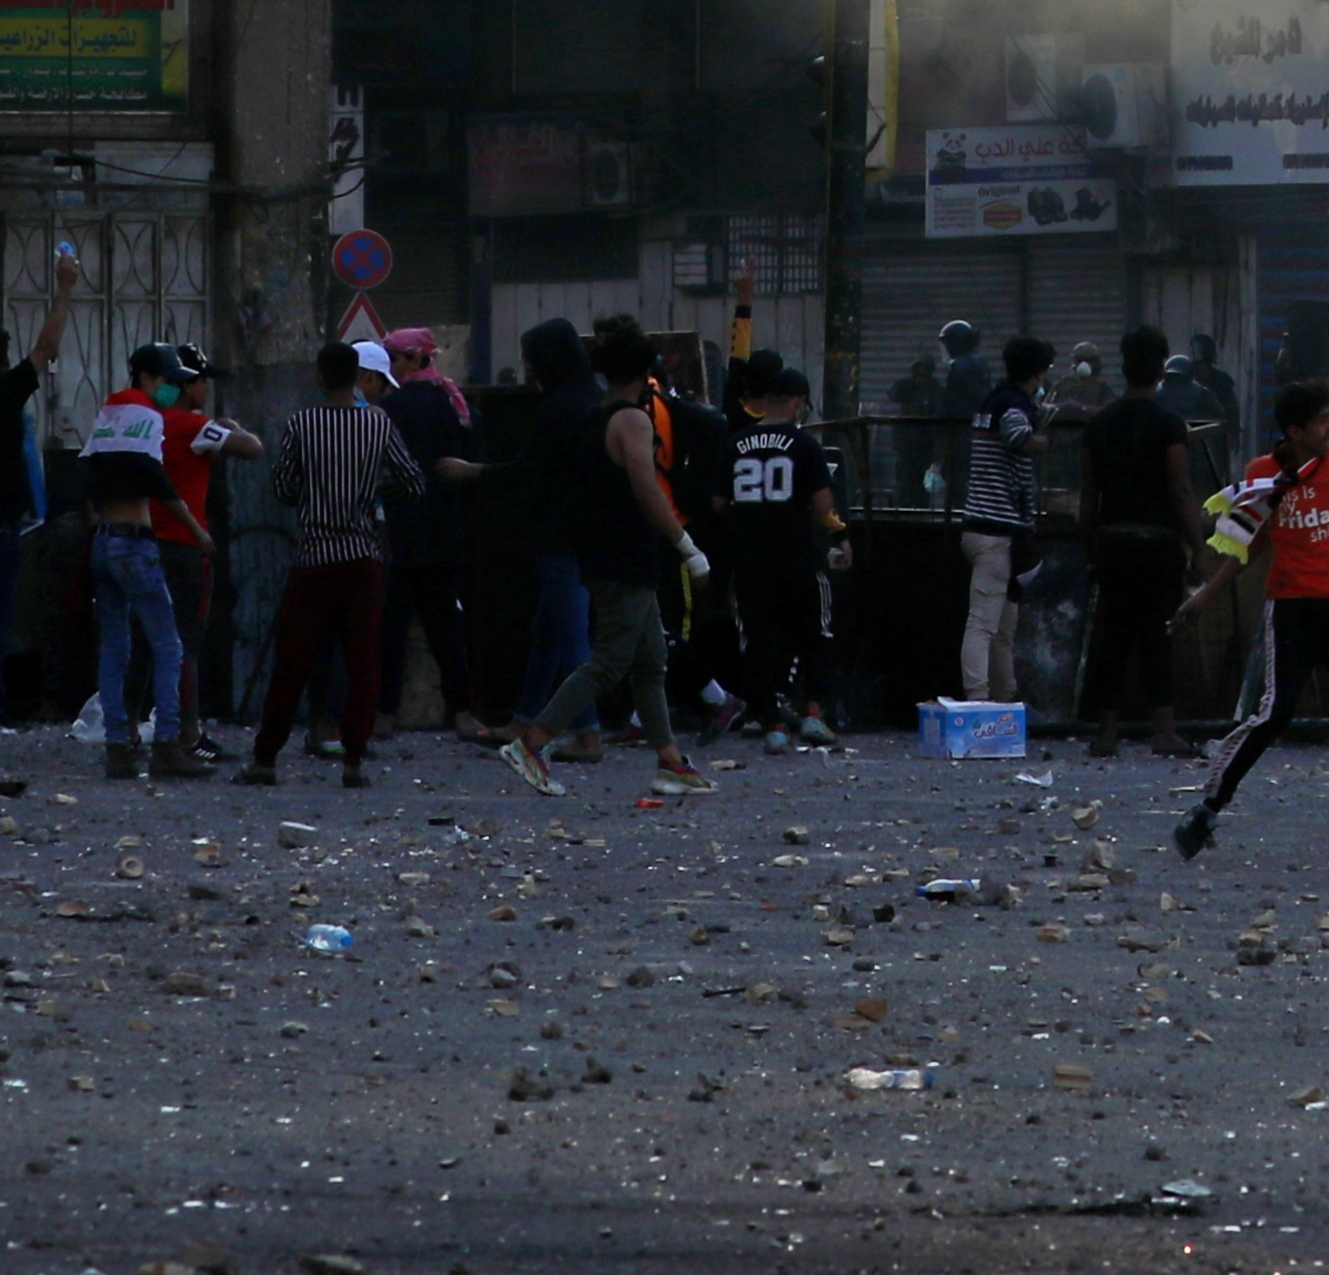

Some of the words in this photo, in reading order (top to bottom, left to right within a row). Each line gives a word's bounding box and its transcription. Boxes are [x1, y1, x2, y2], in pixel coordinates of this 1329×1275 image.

[1018, 137, 1054, 162] علي
[735, 432, 796, 455] GINOBILI
[732, 455, 796, 504] 20
